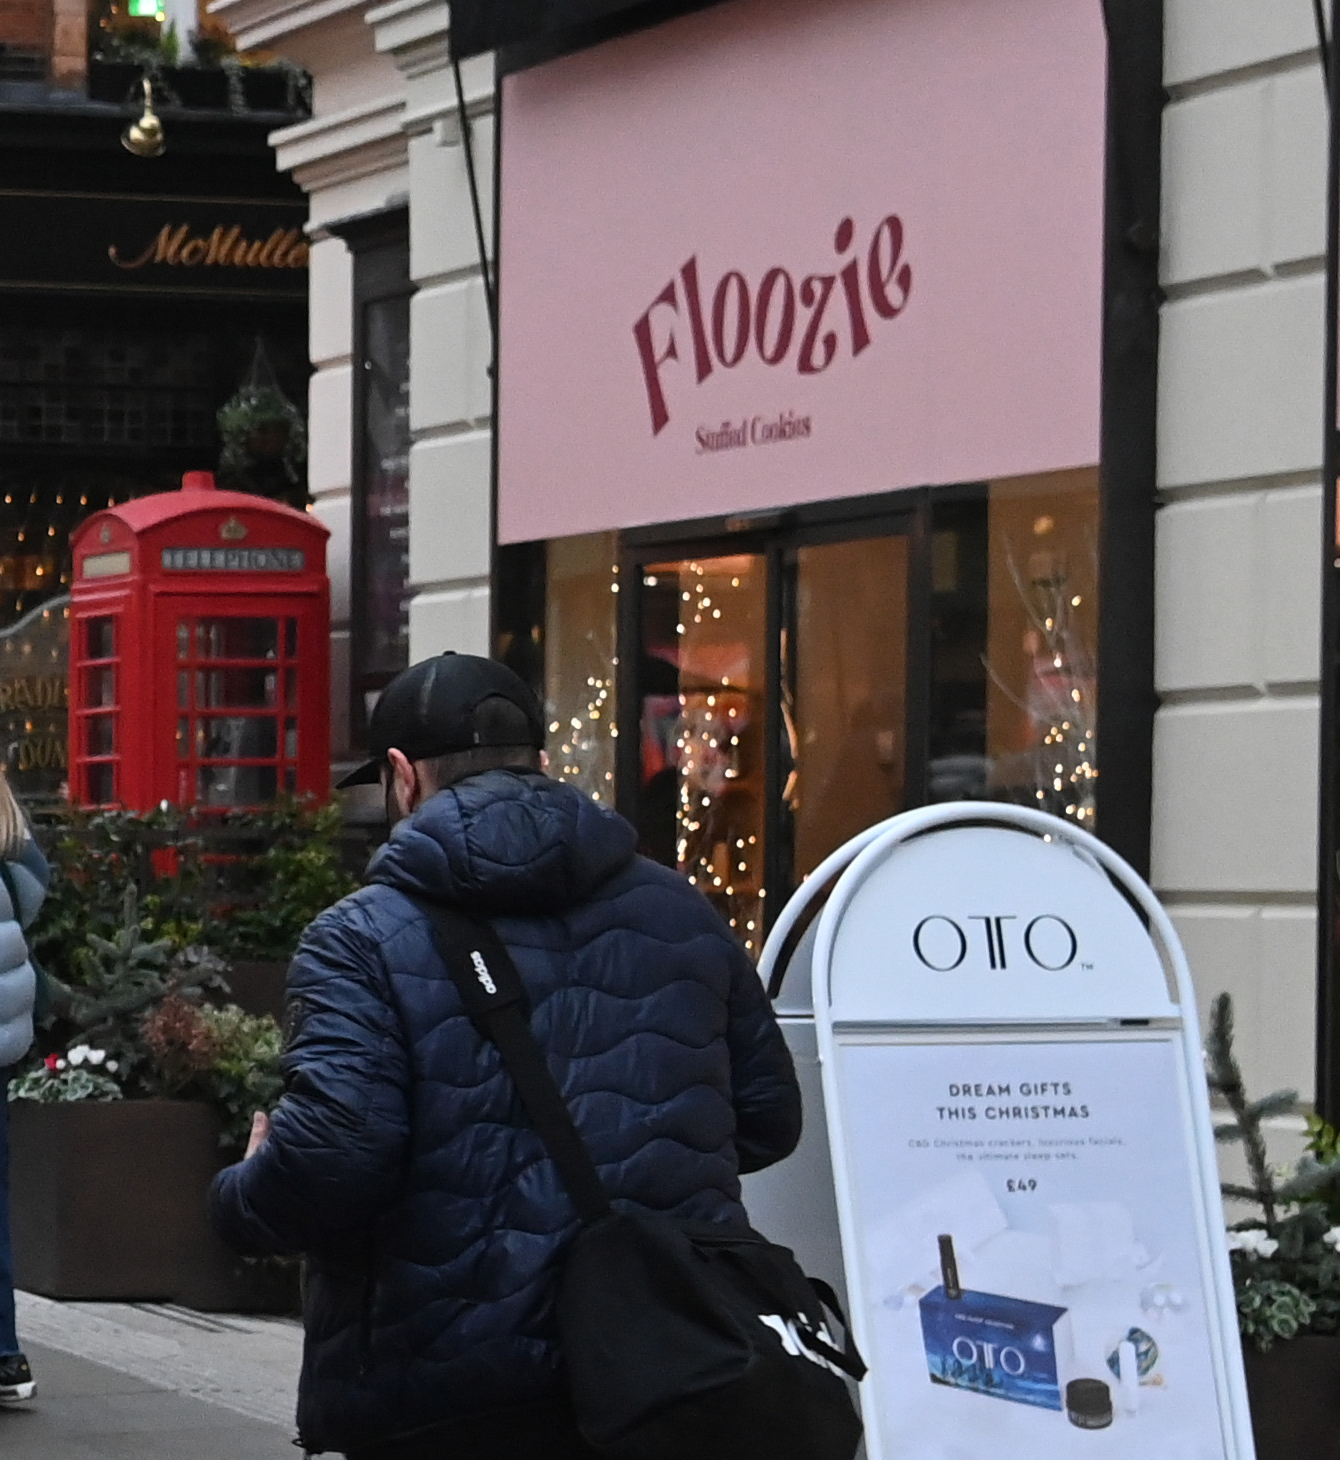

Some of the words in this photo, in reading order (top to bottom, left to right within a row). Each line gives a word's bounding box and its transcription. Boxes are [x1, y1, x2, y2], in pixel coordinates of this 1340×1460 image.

[107, 223, 310, 269] McMulle
[632, 213, 913, 438] Floozie
[750, 410, 812, 447] Cookies
[162, 549, 304, 570] TELEPHONE
[912, 913, 1078, 973] OTO
[469, 950, 497, 995] adidas
[948, 1083, 1012, 1098] DREAM
[1018, 1081, 1072, 1097] GIFTS
[936, 1106, 977, 1121] THIS
[984, 1104, 1090, 1120] CHRISTMAS
[1006, 1178, 1038, 1193] £49
[951, 1336, 1026, 1376] OTO
